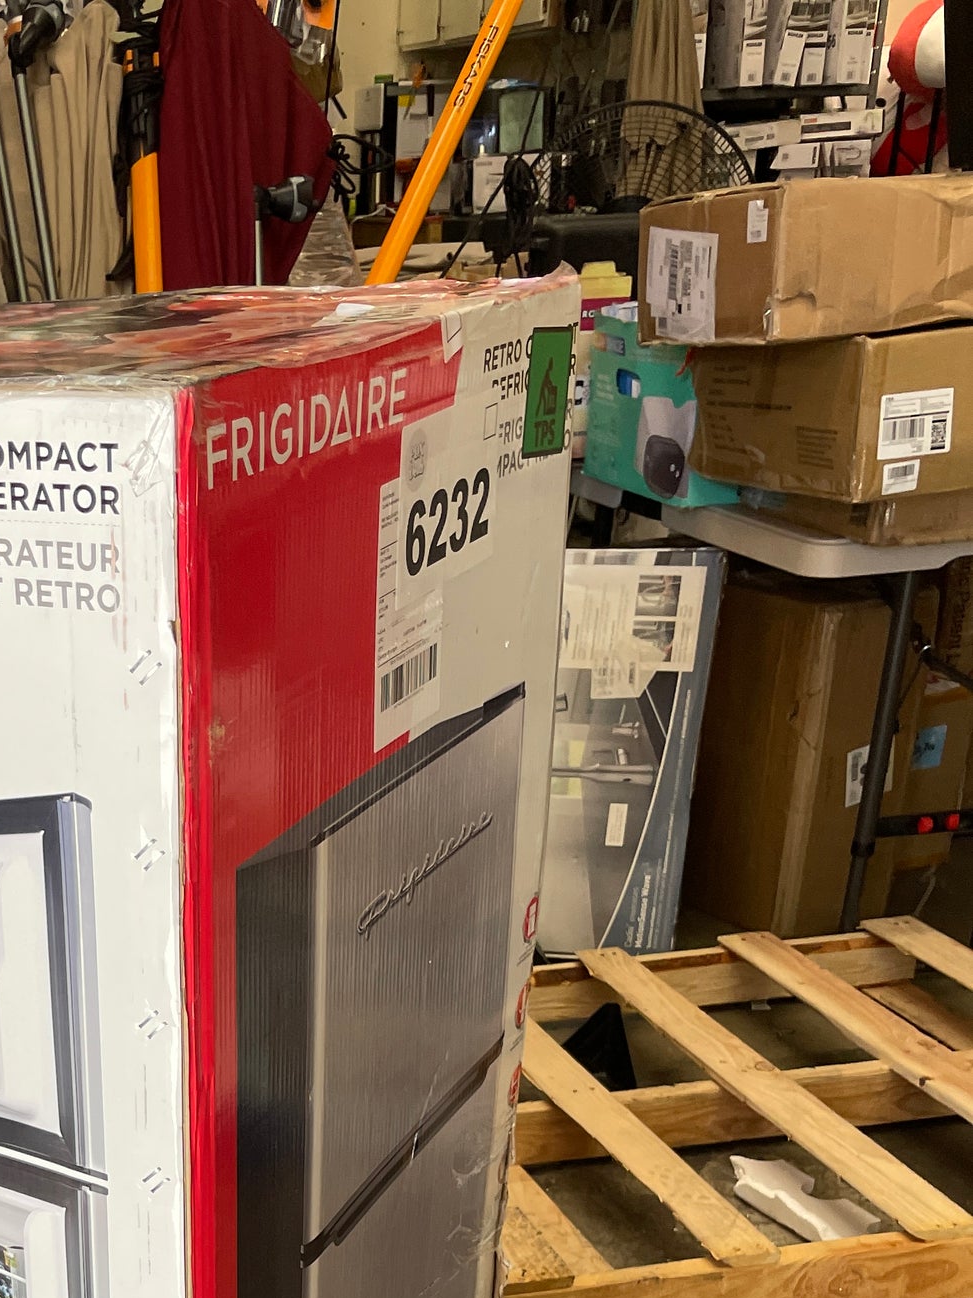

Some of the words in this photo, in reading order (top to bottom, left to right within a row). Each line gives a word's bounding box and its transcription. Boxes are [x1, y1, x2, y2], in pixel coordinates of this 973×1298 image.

[483, 340, 522, 374] RETRO
[206, 366, 407, 490] FRIGIDAIRE
[534, 419, 556, 448] TPS
[405, 467, 490, 576] 6232
[13, 578, 121, 614] RETRO
